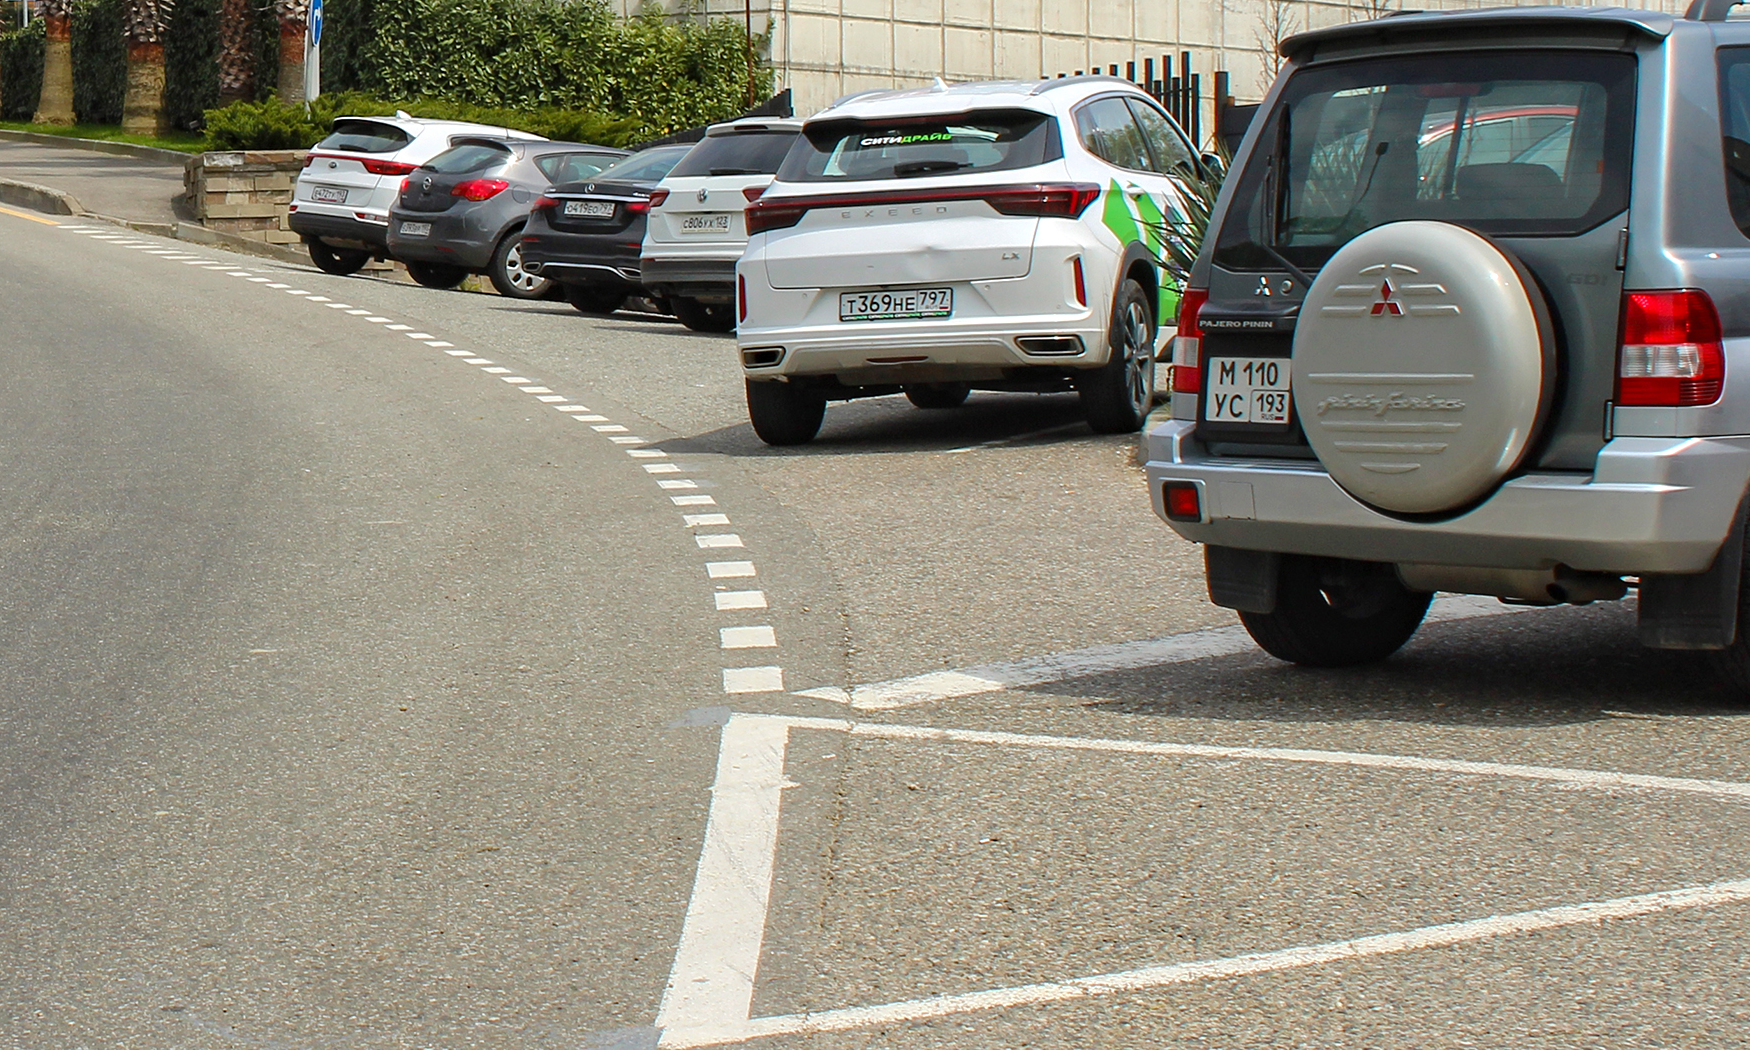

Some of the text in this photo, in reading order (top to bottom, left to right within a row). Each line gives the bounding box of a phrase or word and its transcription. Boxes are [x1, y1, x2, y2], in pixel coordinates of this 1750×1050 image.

[861, 133, 951, 146] СИТИДРАЙВ
[841, 206, 947, 218] EXEED
[683, 217, 713, 229] С806УХ
[1002, 252, 1020, 260] LX
[847, 291, 947, 313] Т369НЕ 797
[1199, 320, 1242, 328] PAJERO
[1219, 361, 1278, 386] М 110
[1215, 393, 1285, 418] УС 193
[1261, 413, 1274, 421] RUS
